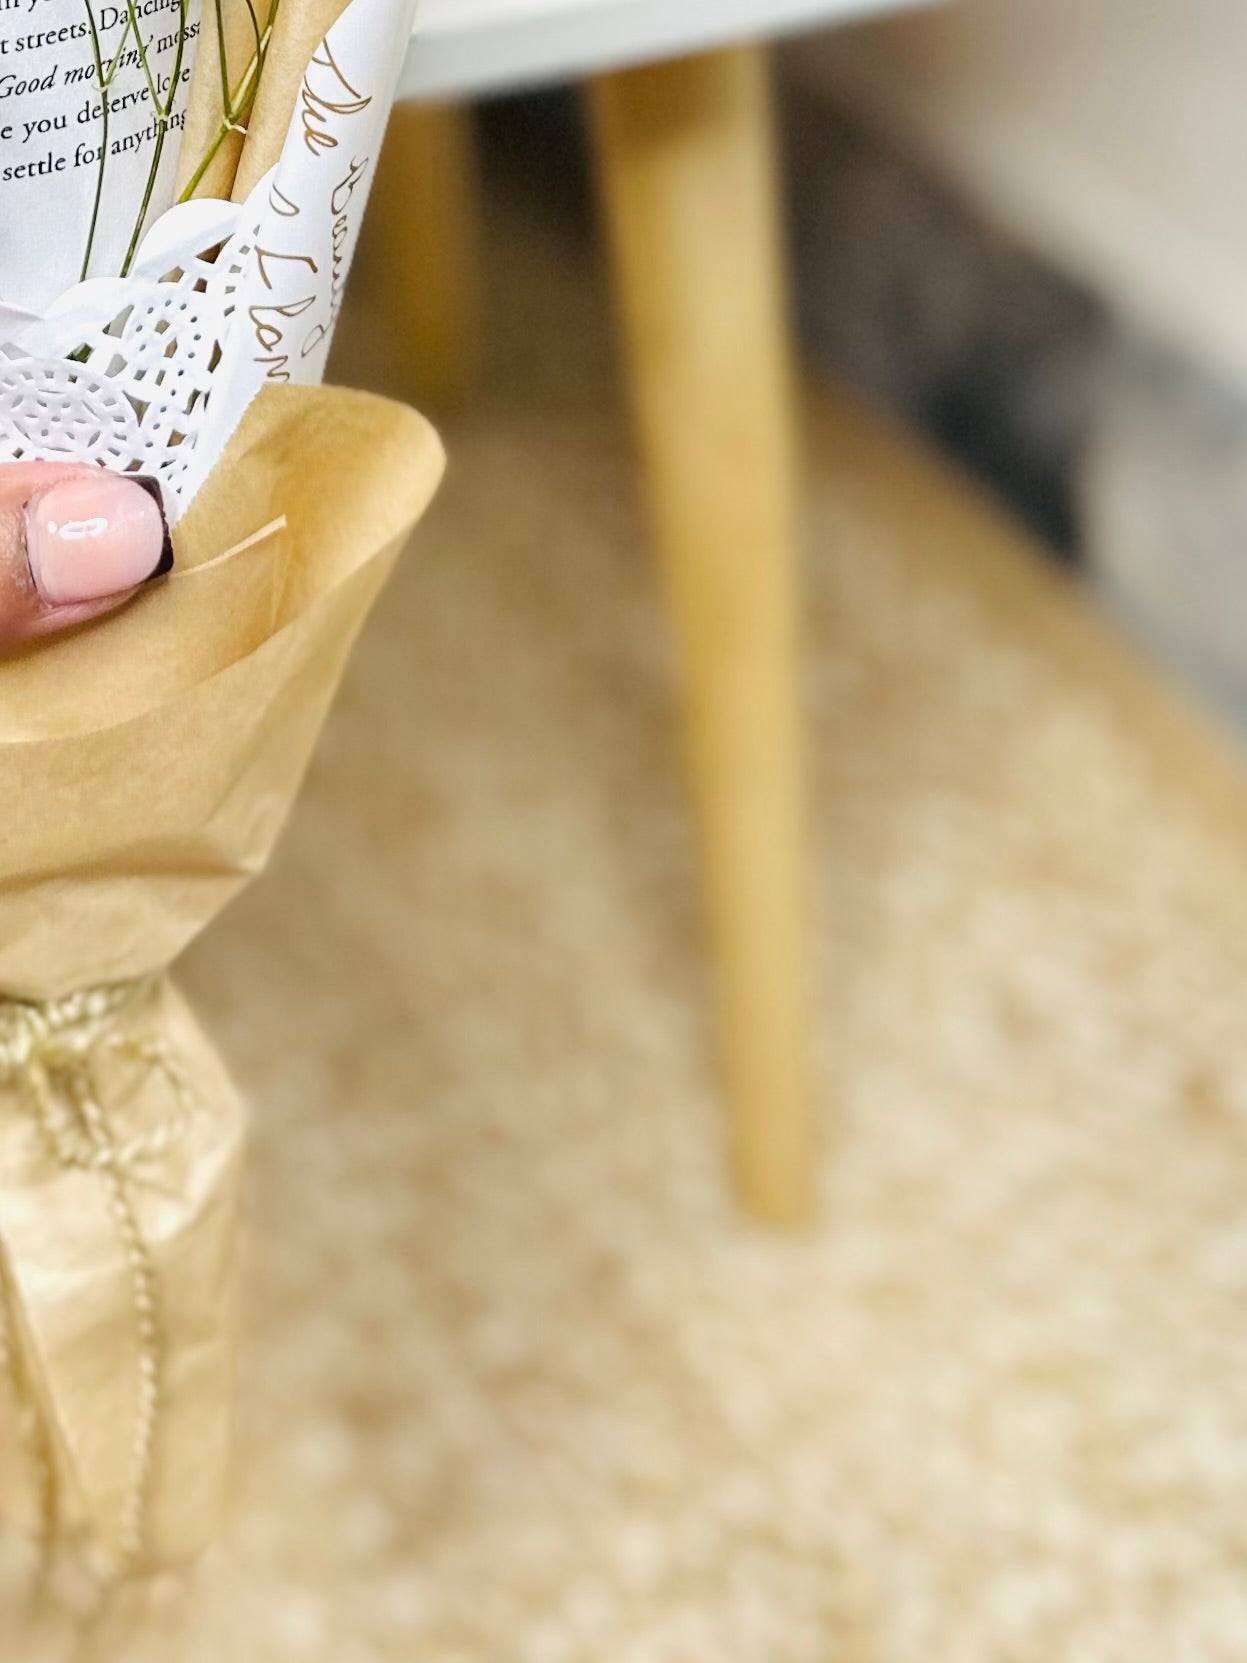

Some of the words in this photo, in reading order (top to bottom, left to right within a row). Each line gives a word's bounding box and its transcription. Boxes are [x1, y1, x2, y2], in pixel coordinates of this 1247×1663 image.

[15, 22, 92, 52] streets.
[23, 114, 67, 143] you
[156, 67, 190, 95] loe
[2, 152, 66, 181] settle
[74, 143, 103, 168] for
[111, 109, 187, 154] anythng
